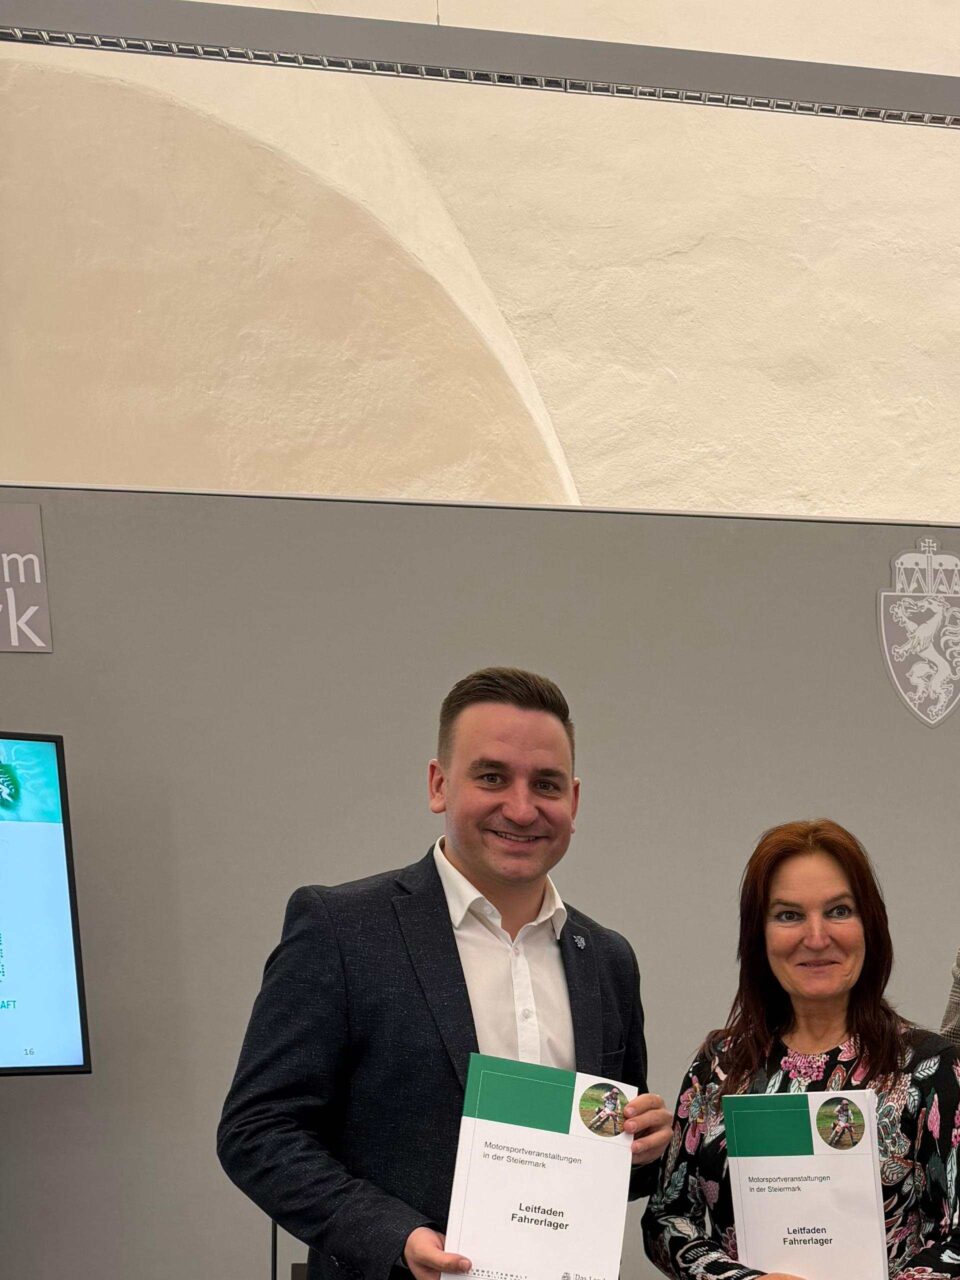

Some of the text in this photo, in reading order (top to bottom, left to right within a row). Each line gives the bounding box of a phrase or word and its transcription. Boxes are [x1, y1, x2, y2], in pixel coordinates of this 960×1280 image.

[23, 1048, 35, 1056] 16
[484, 1140, 582, 1165] Motorsportveranstaltungen
[491, 1153, 505, 1162] der
[506, 1155, 547, 1169] Steiermark
[748, 1174, 831, 1184] Motorsportveranstaltungen
[755, 1185, 766, 1193] der
[767, 1184, 802, 1193] Steiermark
[518, 1202, 565, 1218] Leitfaden
[510, 1213, 569, 1231] Fahrerlager
[787, 1226, 827, 1235] Leitfaden
[783, 1236, 833, 1247] Fahrerlager
